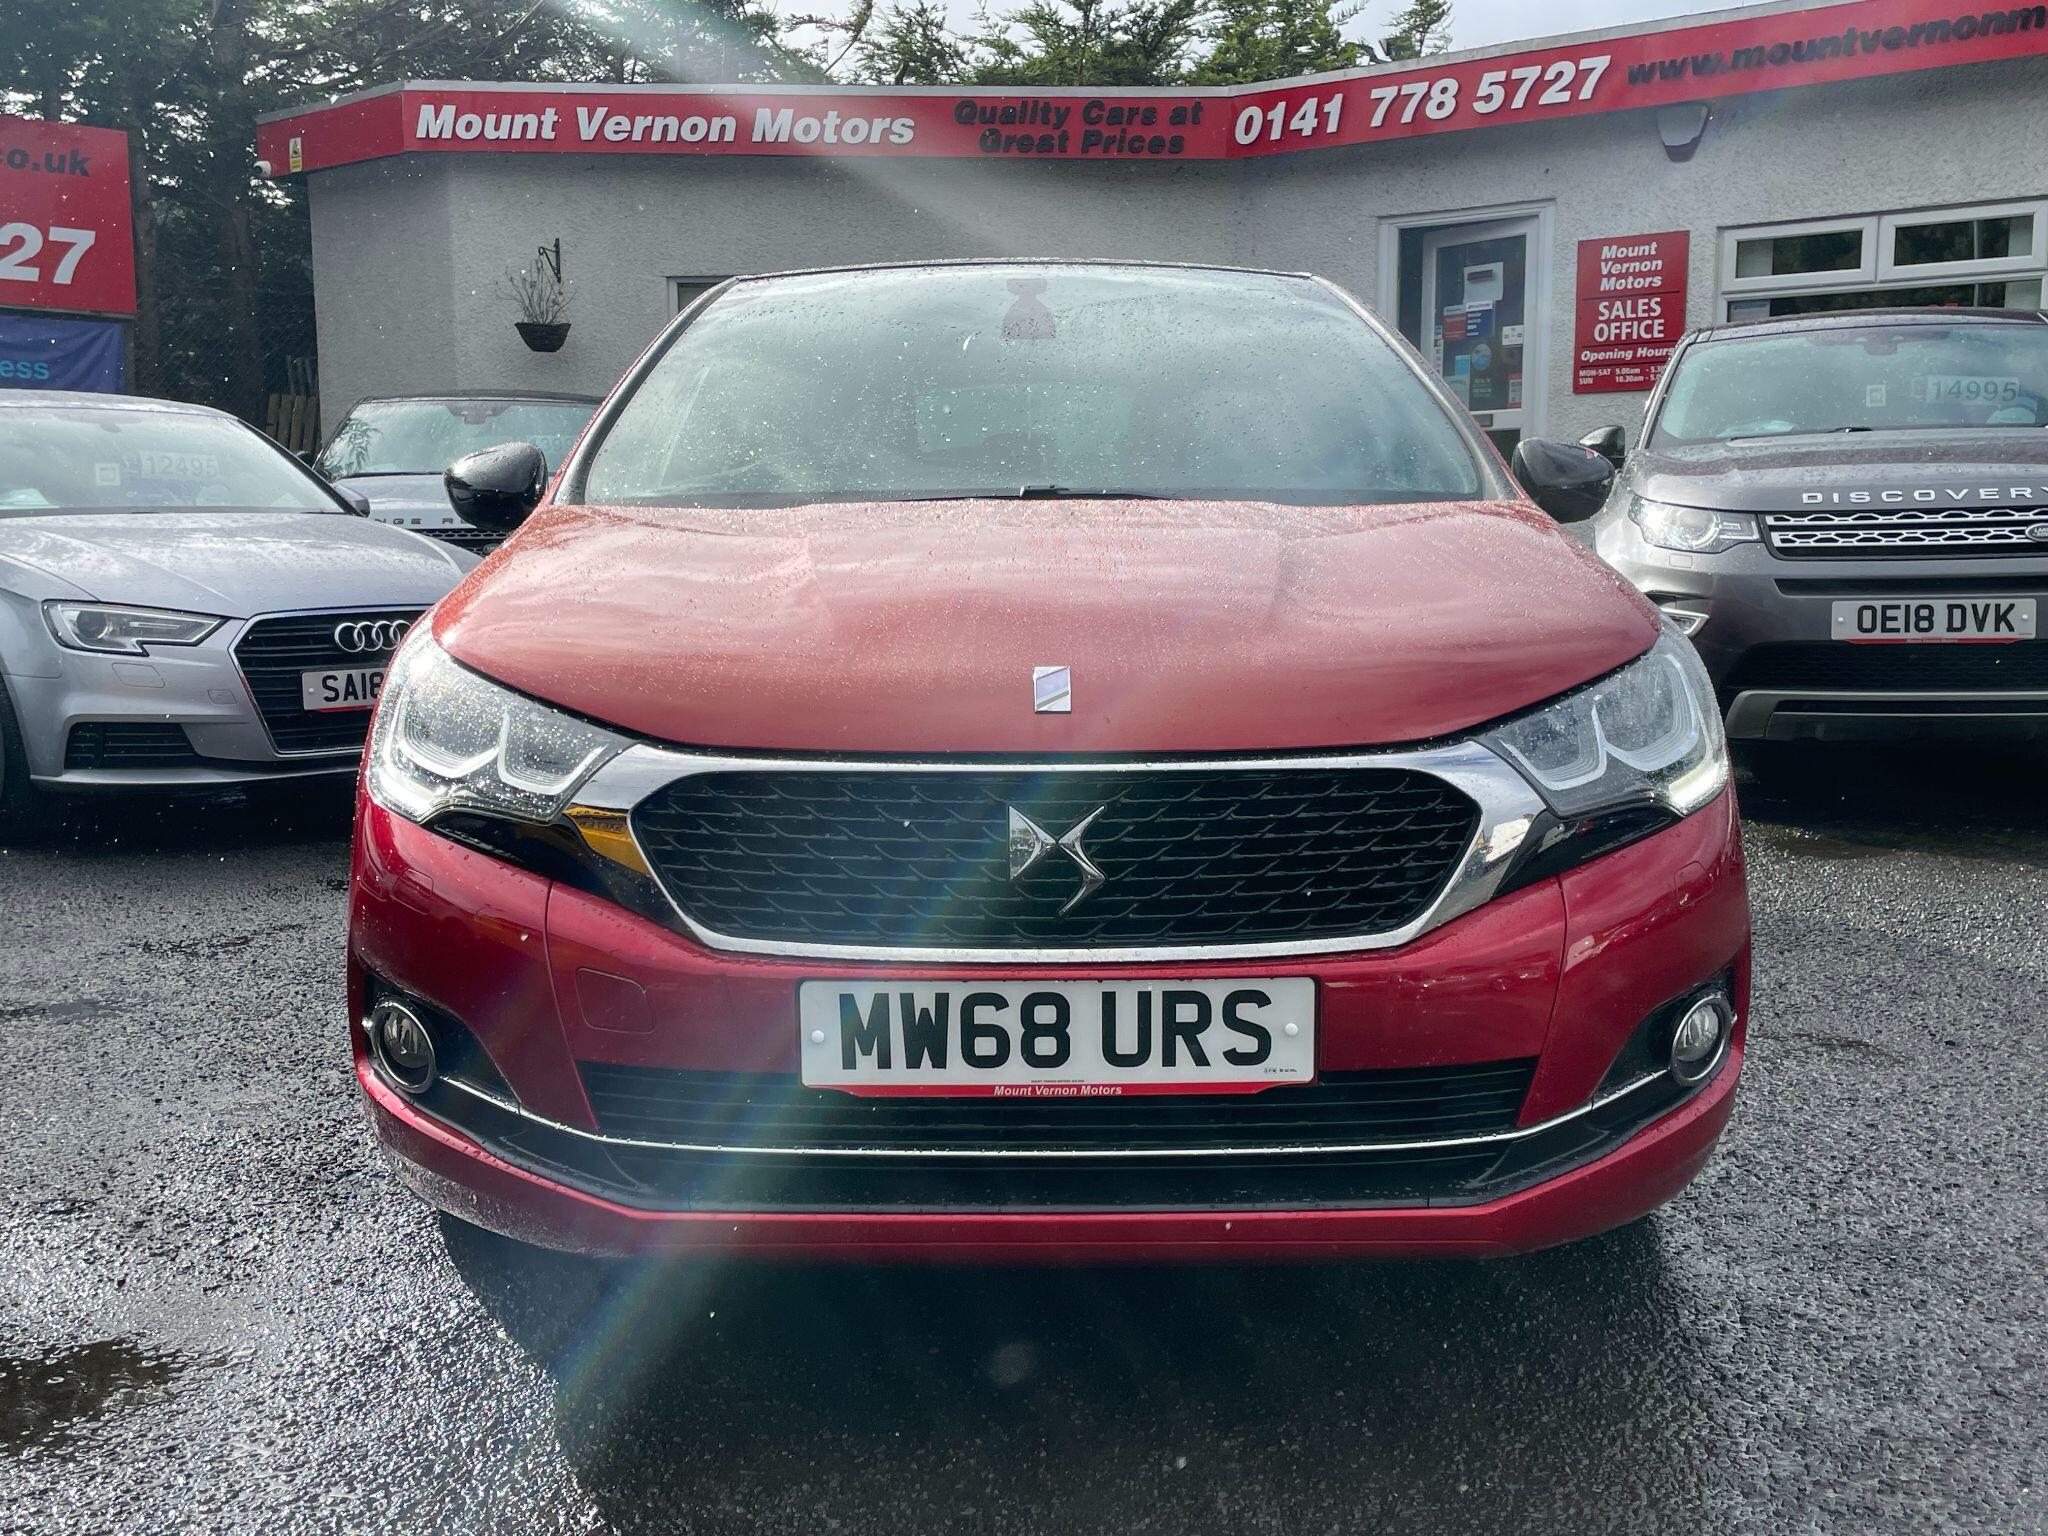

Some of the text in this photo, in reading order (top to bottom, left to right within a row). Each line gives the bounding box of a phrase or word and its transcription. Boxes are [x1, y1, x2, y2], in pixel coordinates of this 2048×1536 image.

[1234, 55, 1612, 145] 0141 778 5727
[415, 104, 915, 145] Mount Vernon Motors
[955, 100, 1203, 130] Quality Cars at
[979, 128, 1185, 155] Great Prices
[0, 222, 97, 285] 27
[1601, 242, 1658, 260] Mount
[1600, 259, 1663, 275] Vernon
[1600, 276, 1662, 291] Motors
[1598, 298, 1662, 320] SALES
[1594, 319, 1664, 342] OFFICE
[1581, 349, 1633, 362] Opening
[0, 360, 49, 380] ess
[1857, 603, 2016, 633] OE18 DVK
[839, 989, 1273, 1070] MW68 URS
[993, 1085, 1122, 1097] Mount Vernon Motors
